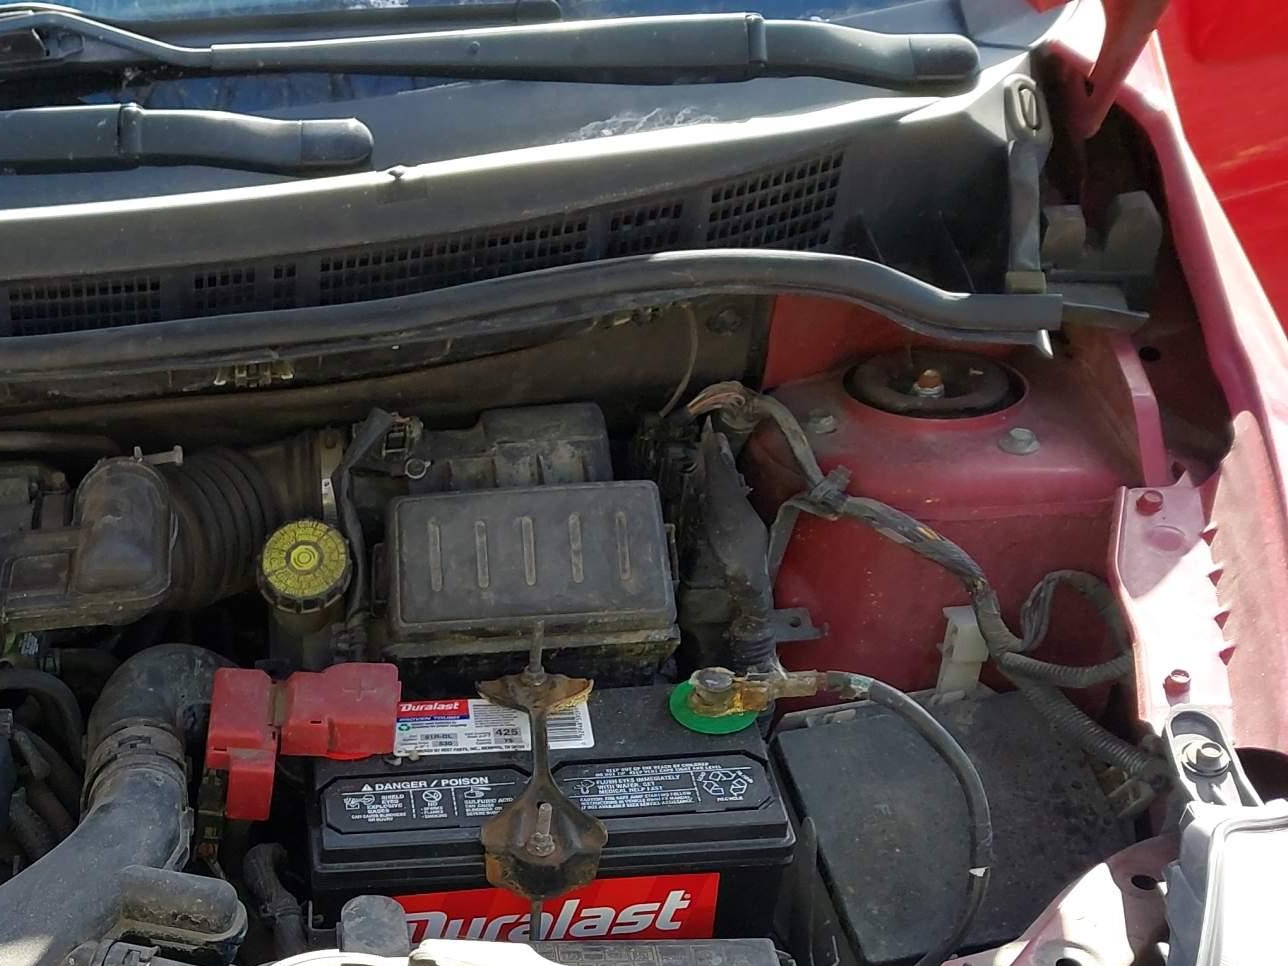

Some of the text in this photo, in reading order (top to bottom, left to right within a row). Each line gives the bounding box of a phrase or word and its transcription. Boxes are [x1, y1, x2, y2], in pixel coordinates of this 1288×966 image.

[400, 702, 459, 712] Duralast
[495, 728, 519, 736] 425
[636, 774, 680, 782] IMMEDIATELY
[374, 776, 489, 791] DANGER / POISON
[405, 890, 689, 940] Duralast
